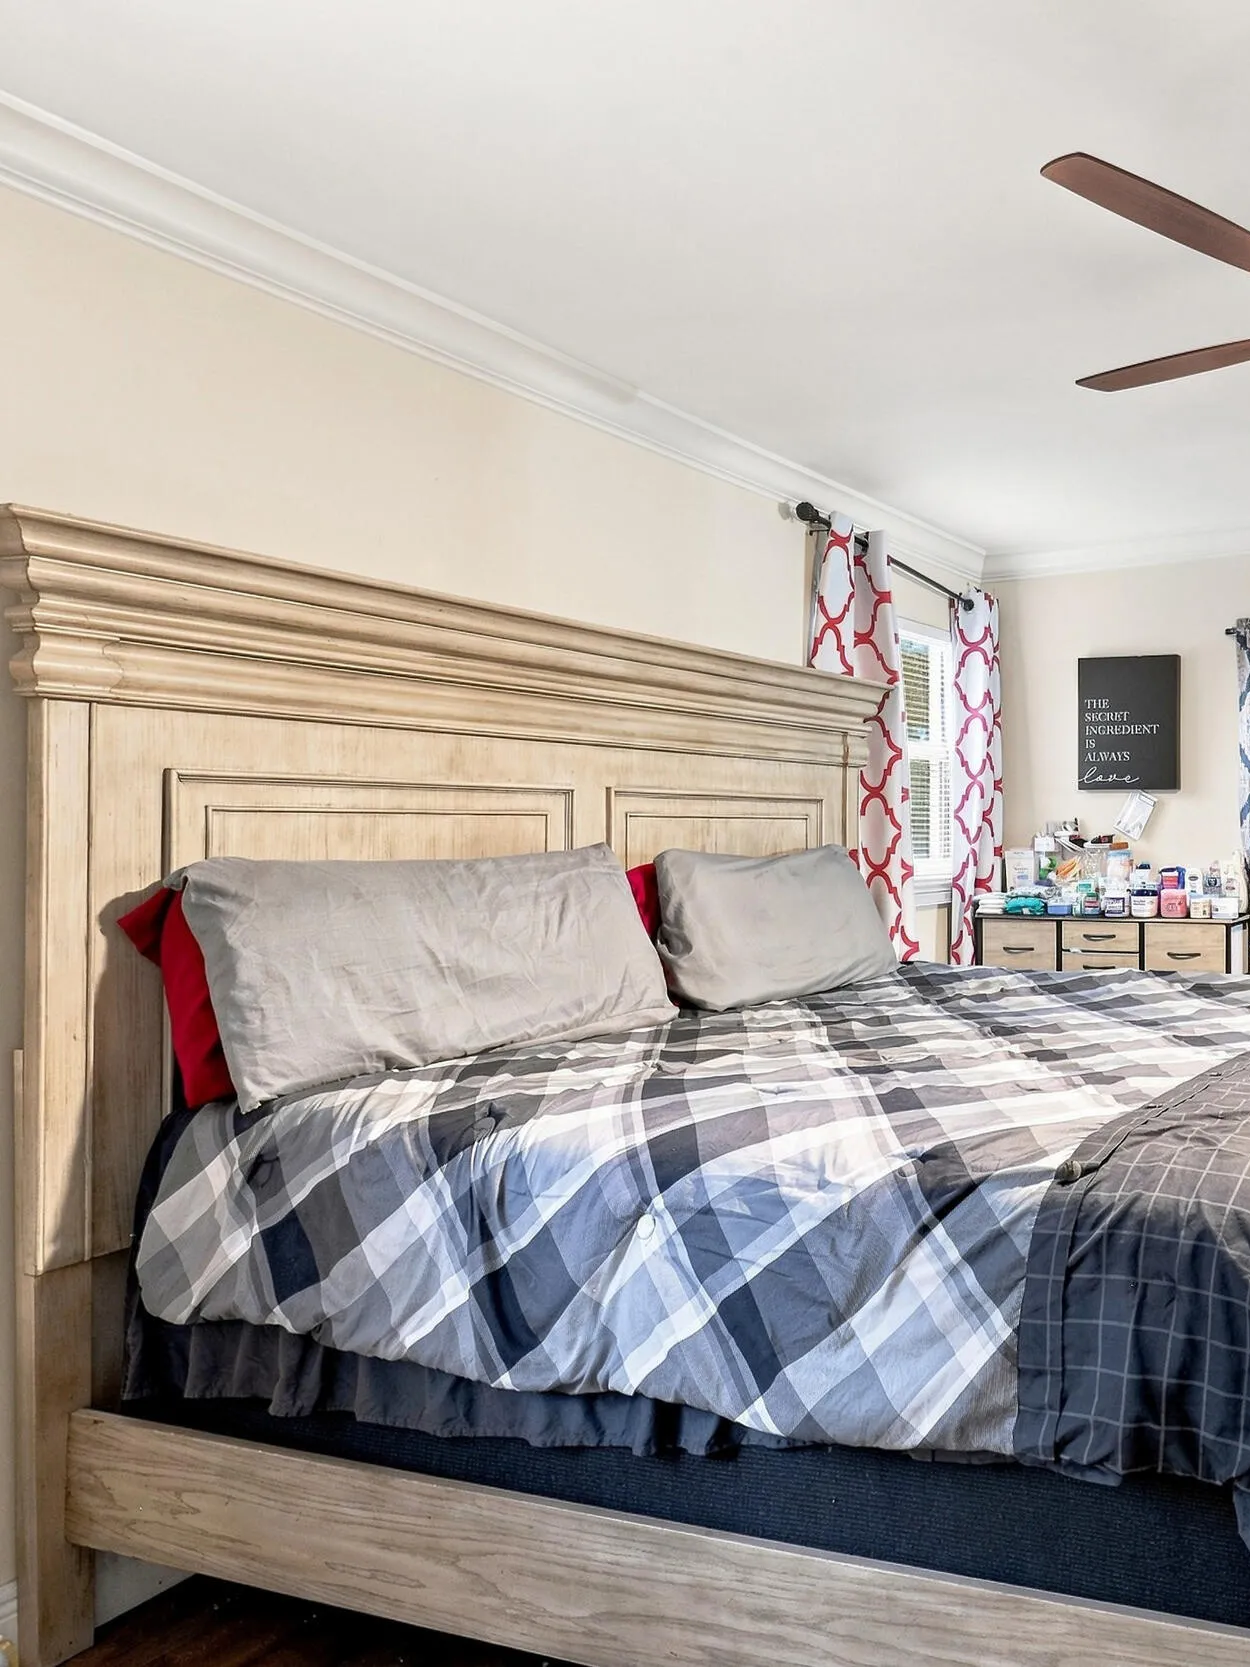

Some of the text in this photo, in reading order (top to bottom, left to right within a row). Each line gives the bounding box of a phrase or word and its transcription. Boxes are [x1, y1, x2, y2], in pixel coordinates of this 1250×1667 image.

[1085, 699, 1109, 709] THE
[1085, 711, 1129, 722] SECRET
[1085, 724, 1160, 735] INGREDIENT
[1085, 739, 1096, 749] IS
[1085, 751, 1130, 762] ALWAYS
[1078, 766, 1140, 784] love
